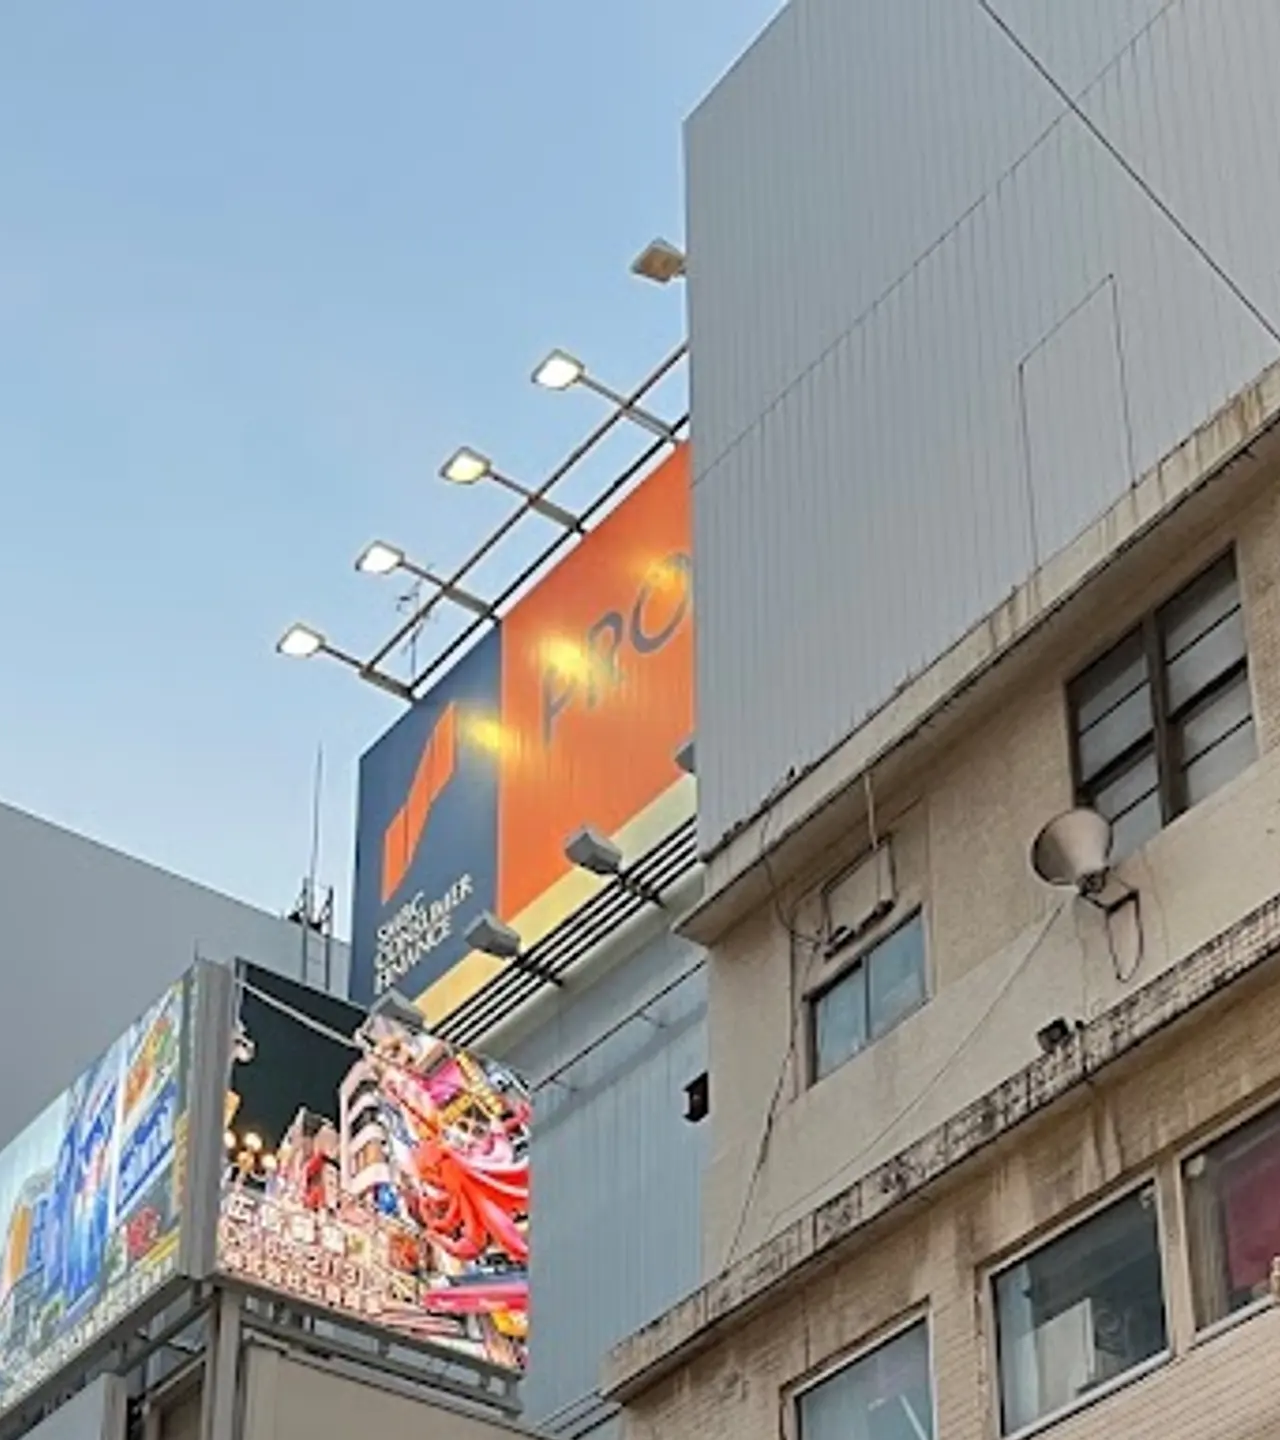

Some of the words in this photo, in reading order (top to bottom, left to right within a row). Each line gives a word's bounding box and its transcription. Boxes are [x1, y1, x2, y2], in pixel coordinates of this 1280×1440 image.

[374, 882, 473, 971] CONSUMER
[374, 914, 451, 995] FINANCE
[377, 888, 424, 941] SMBC
